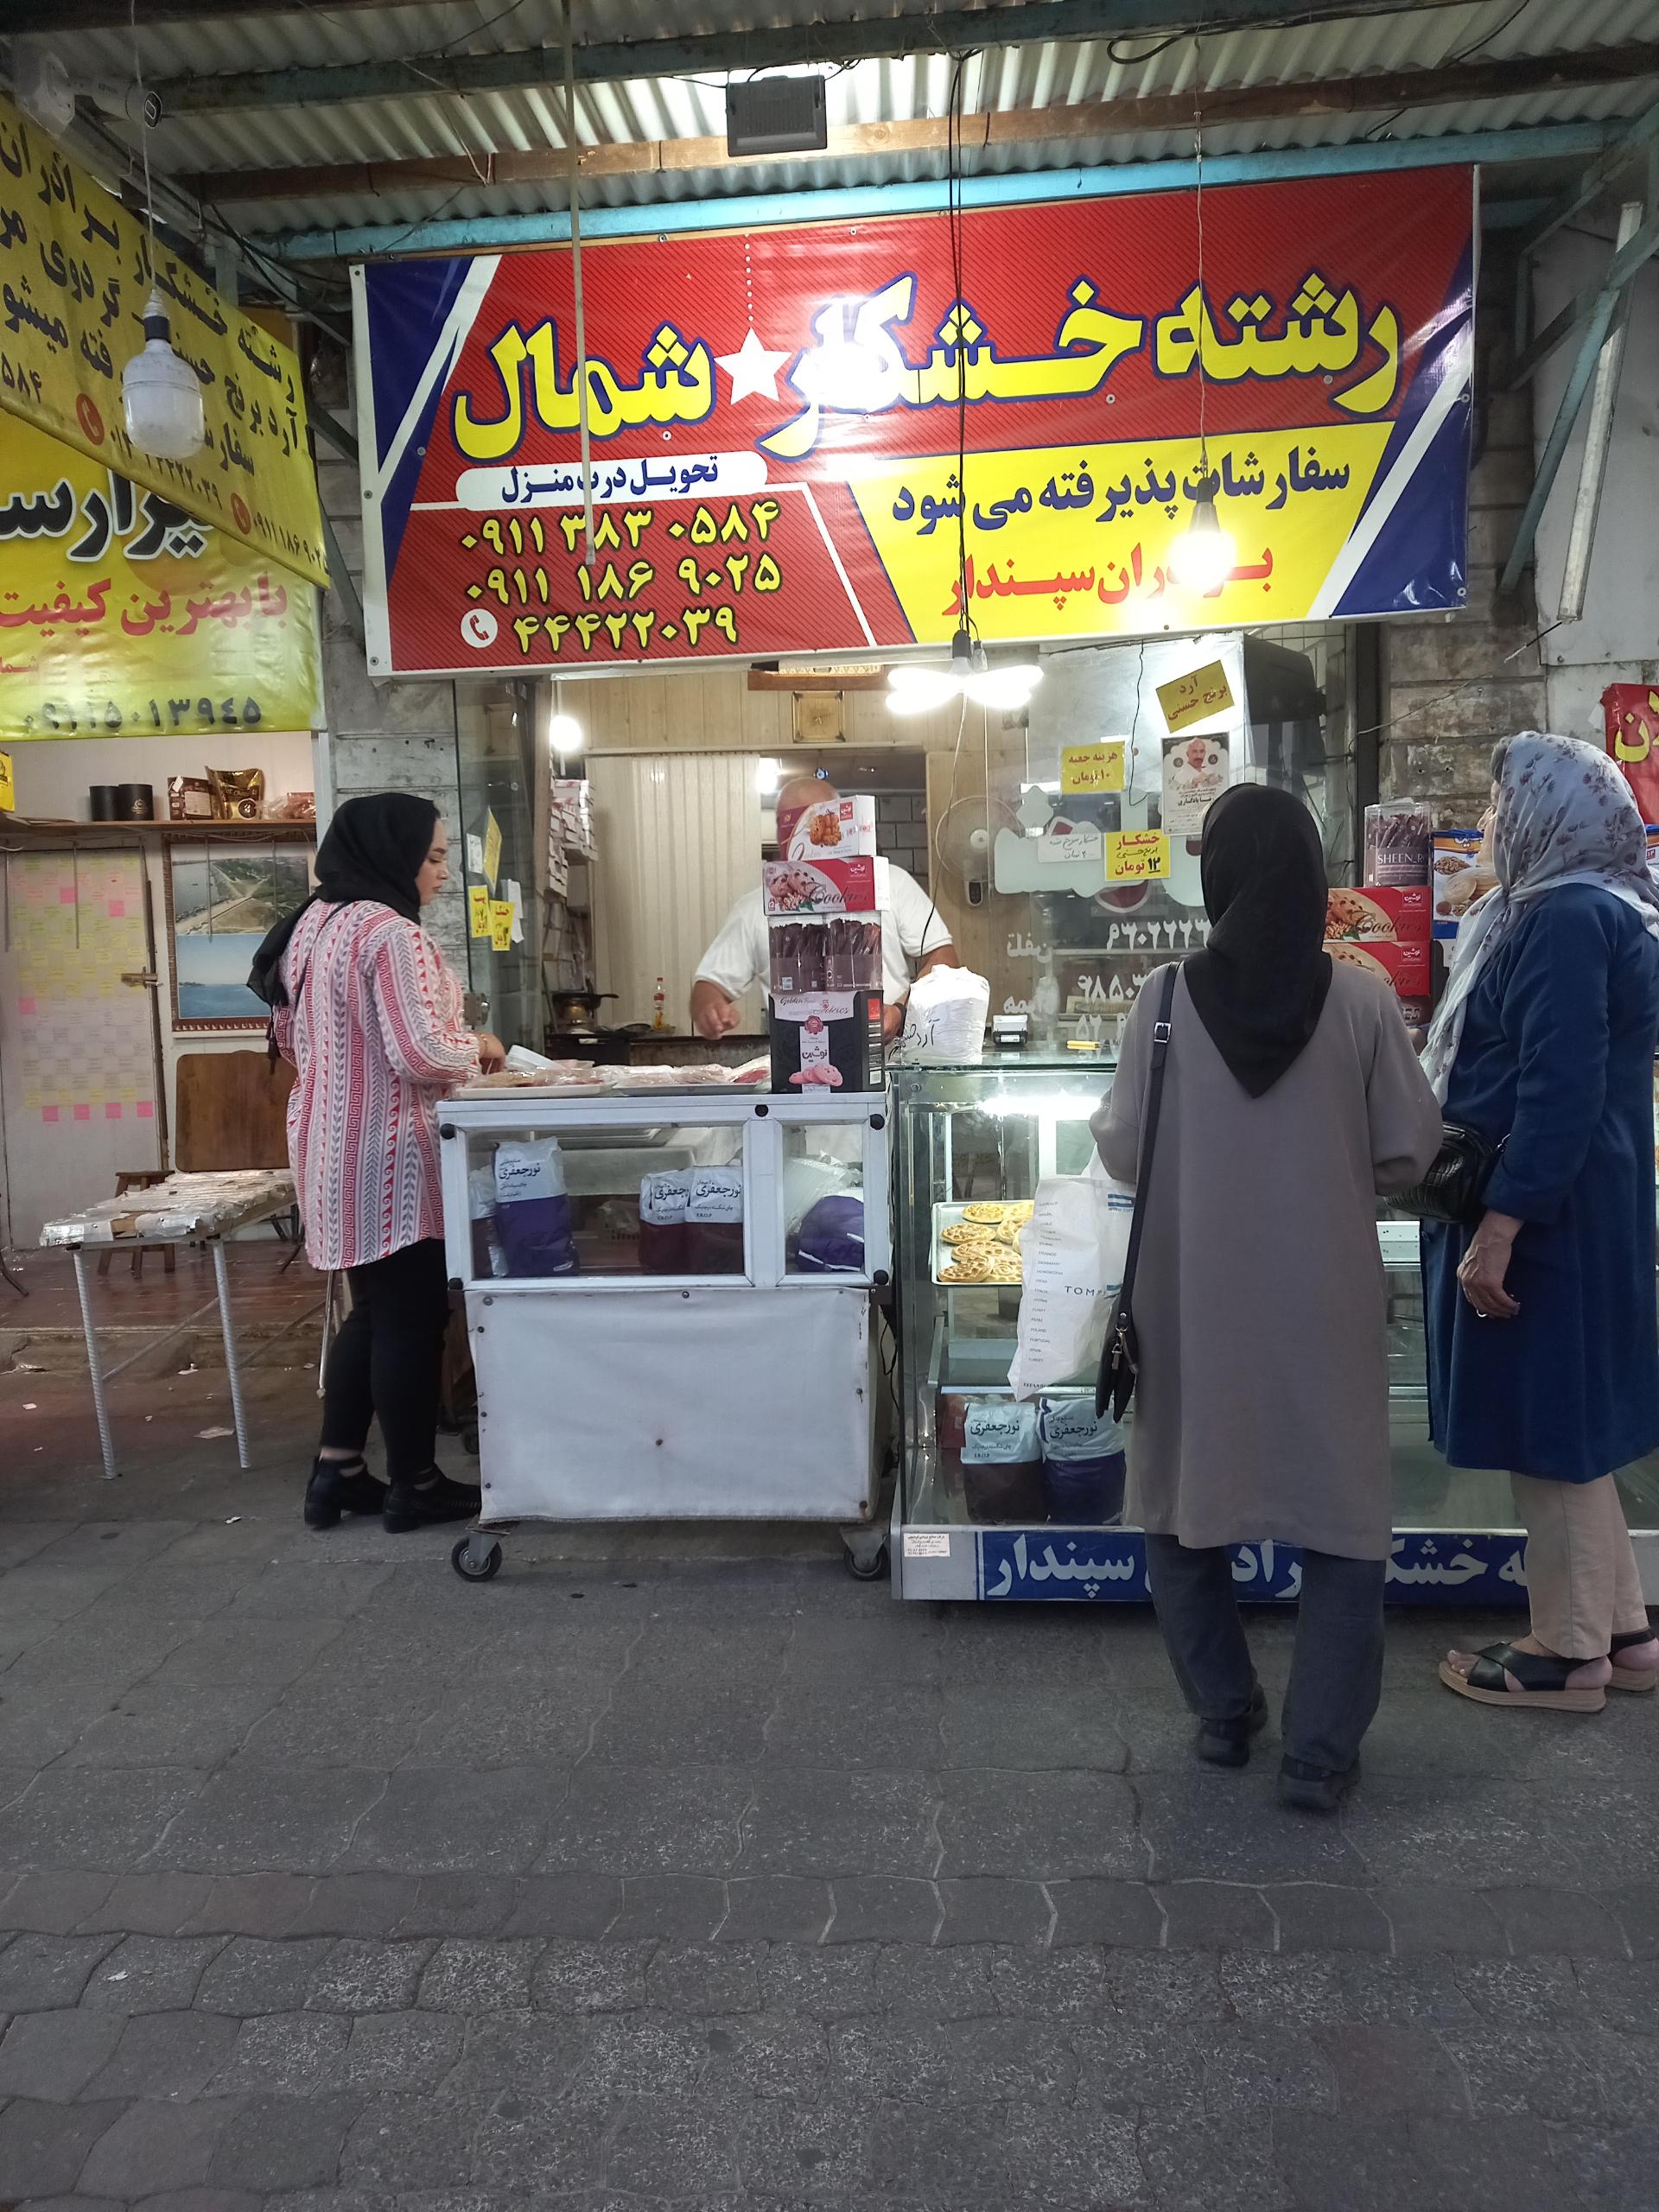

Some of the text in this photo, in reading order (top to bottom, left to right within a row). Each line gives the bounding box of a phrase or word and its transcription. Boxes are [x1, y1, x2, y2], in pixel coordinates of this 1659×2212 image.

[133, 234, 228, 336] خشکار
[238, 326, 295, 404] رشته
[453, 268, 1402, 463] رشته خشکار شمال
[502, 466, 574, 503] منزل
[630, 455, 718, 495] تحویل
[1039, 458, 1179, 523] پذیرفته
[461, 499, 781, 556] ۰۹۱۱ ۳۸۳ ۰۵۸۴
[466, 553, 783, 606] ۰۹۱۱ ۱۸۶ ۹۰۲۵
[942, 554, 1095, 616] سپندار
[0, 578, 111, 638] کیفیت
[121, 580, 253, 637] بهترین
[512, 606, 739, 654] ۴۴۴۲۲۰۳۹
[1168, 684, 1228, 721] برنج حسنی
[1179, 676, 1199, 696] آرد
[1072, 771, 1098, 785] تومان
[1116, 832, 1160, 850] خشکار
[1377, 853, 1424, 864] SHEEN_R
[1115, 860, 1145, 875] تومان
[802, 1046, 828, 1063] نوشین
[988, 1534, 1135, 1599] سپندار
[1385, 1538, 1488, 1585] خشک
